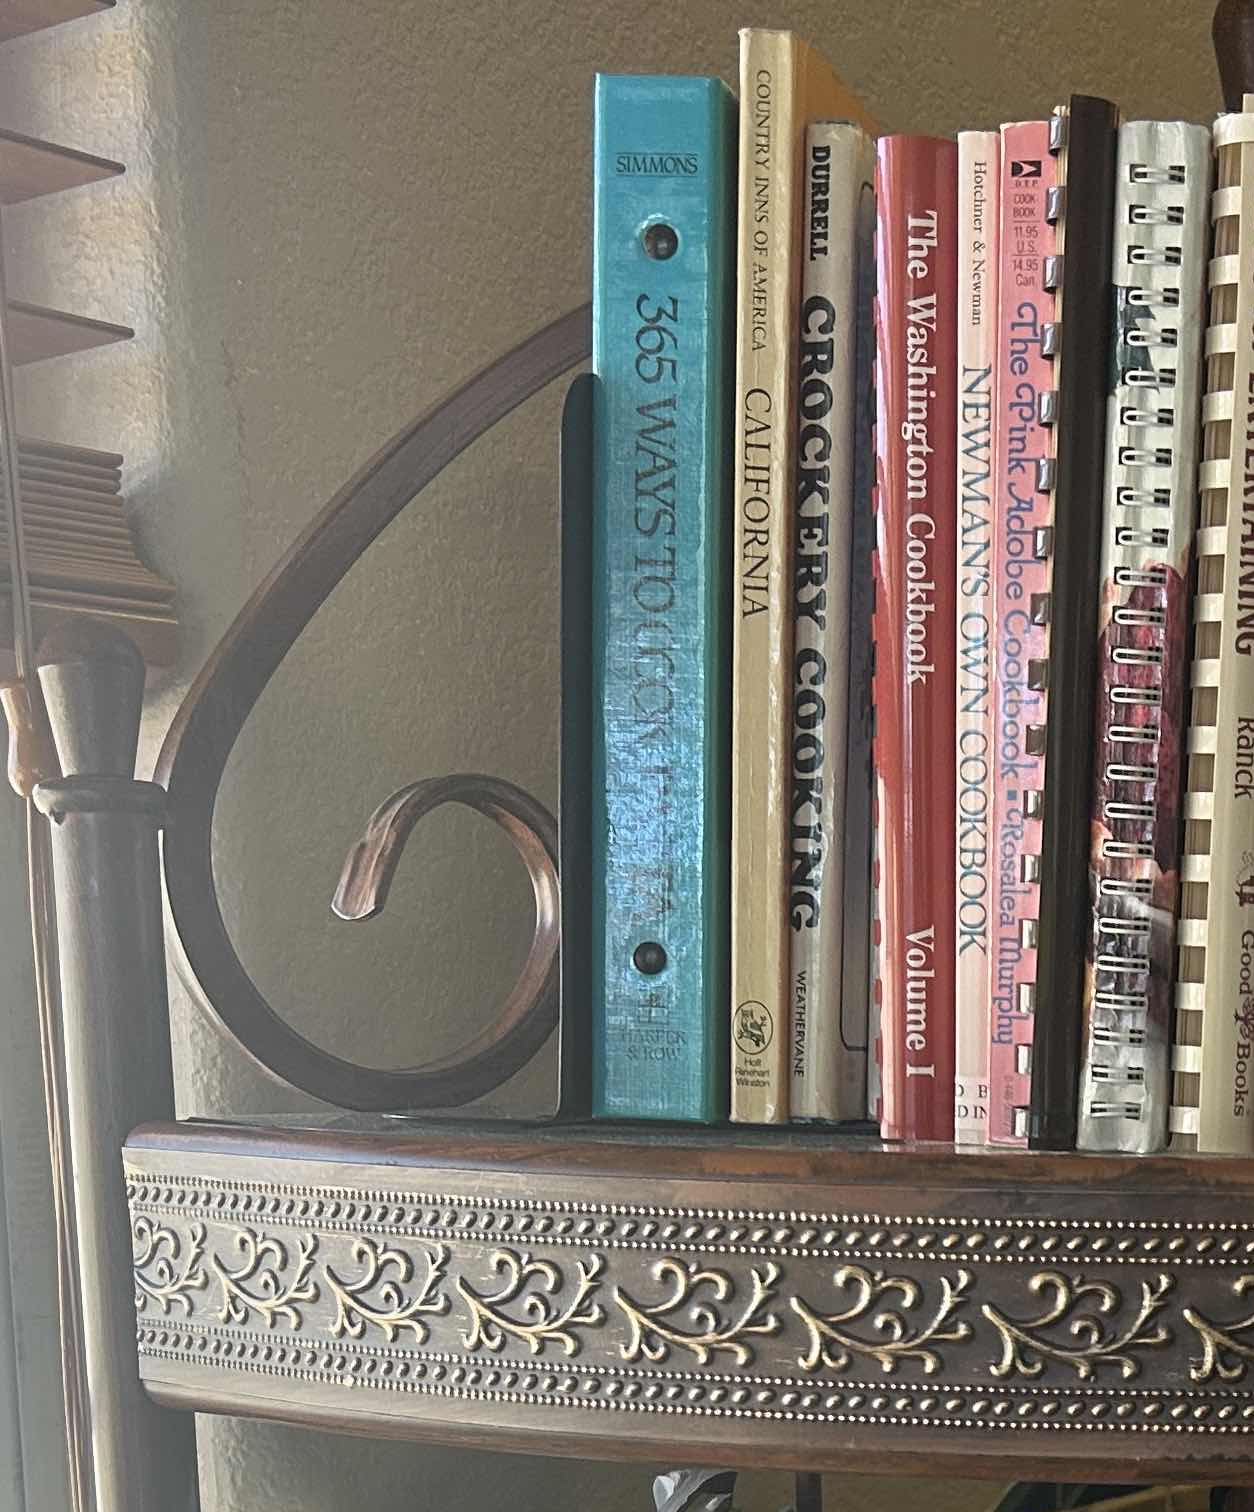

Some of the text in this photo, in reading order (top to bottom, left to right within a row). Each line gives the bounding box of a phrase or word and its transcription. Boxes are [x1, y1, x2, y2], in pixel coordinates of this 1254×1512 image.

[616, 155, 697, 174] SIMMONS
[741, 70, 773, 619] COUNTRY INNS OF AMERICA CALIFORNIA
[900, 211, 938, 1078] The Washington Cookbook Volume I
